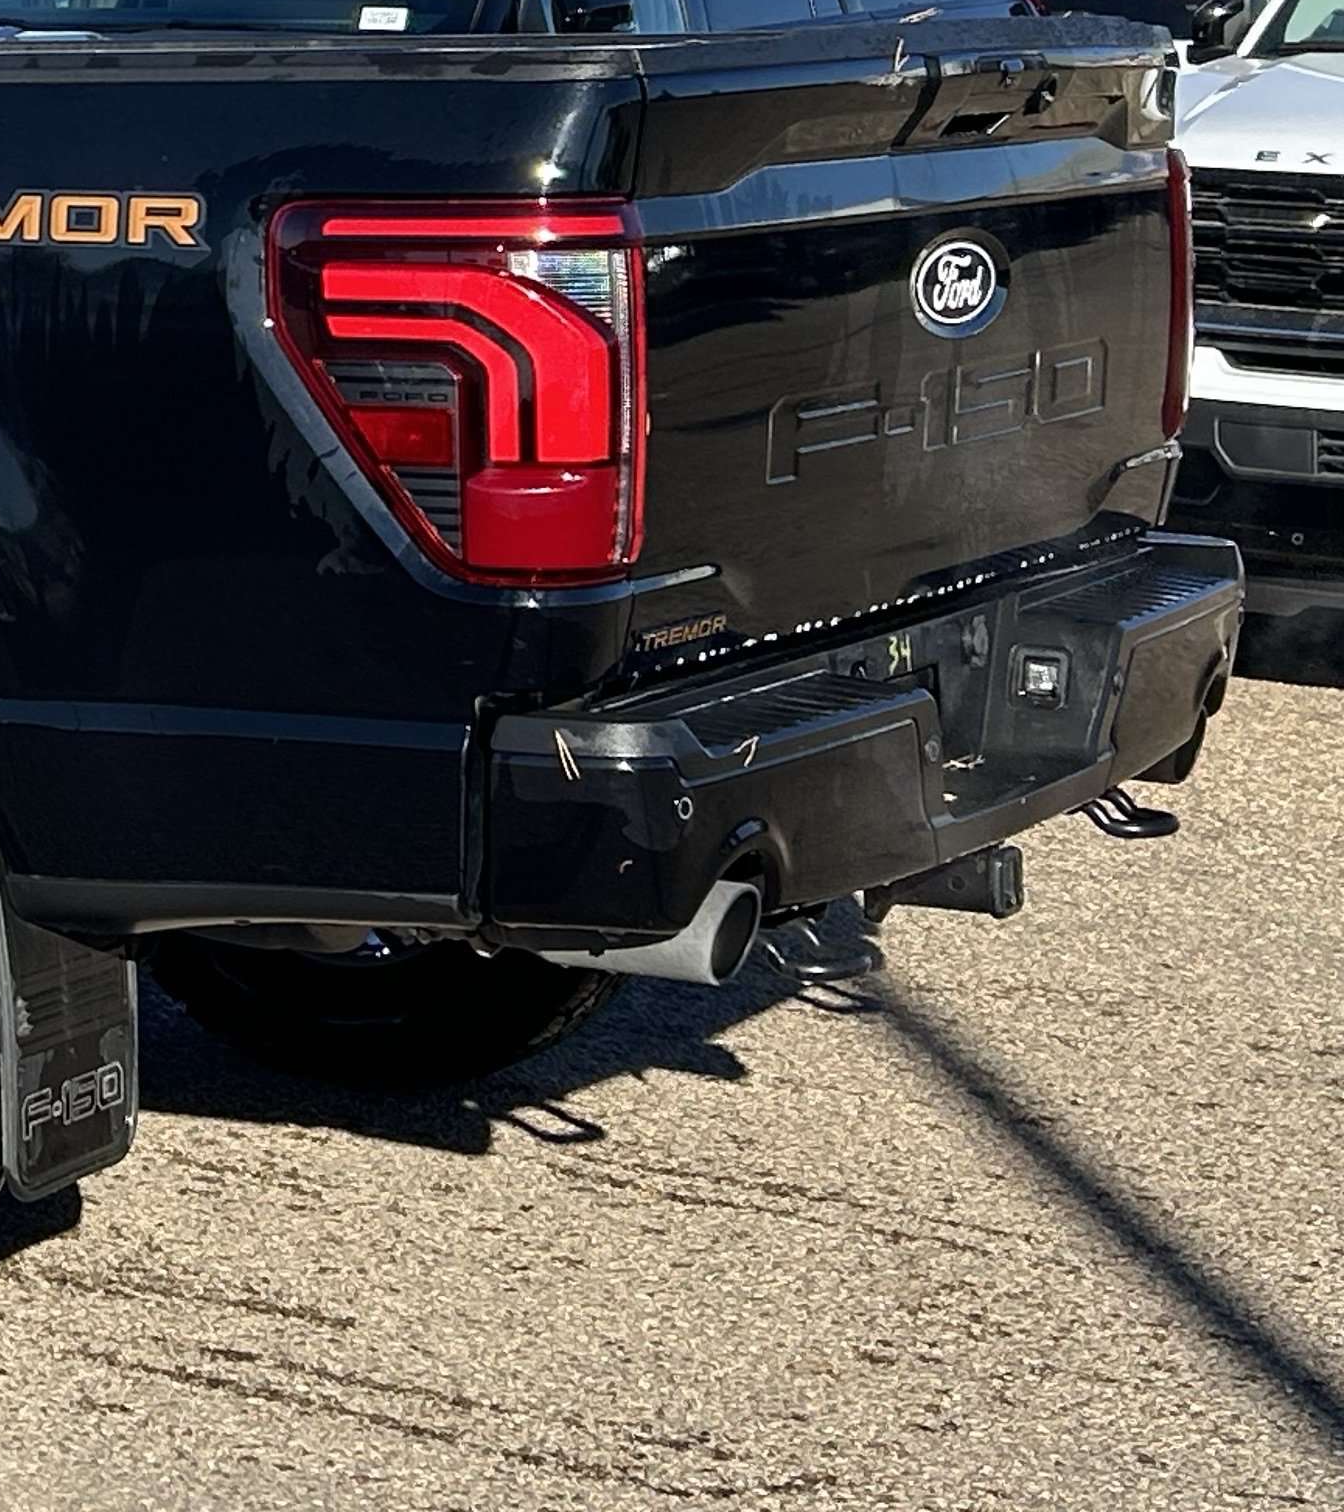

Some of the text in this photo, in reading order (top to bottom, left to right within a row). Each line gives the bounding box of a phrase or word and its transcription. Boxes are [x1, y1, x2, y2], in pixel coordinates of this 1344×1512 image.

[933, 254, 984, 311] Ford
[765, 336, 1109, 485] F-150
[642, 615, 727, 651] TREMOR
[21, 1061, 125, 1141] F-150
